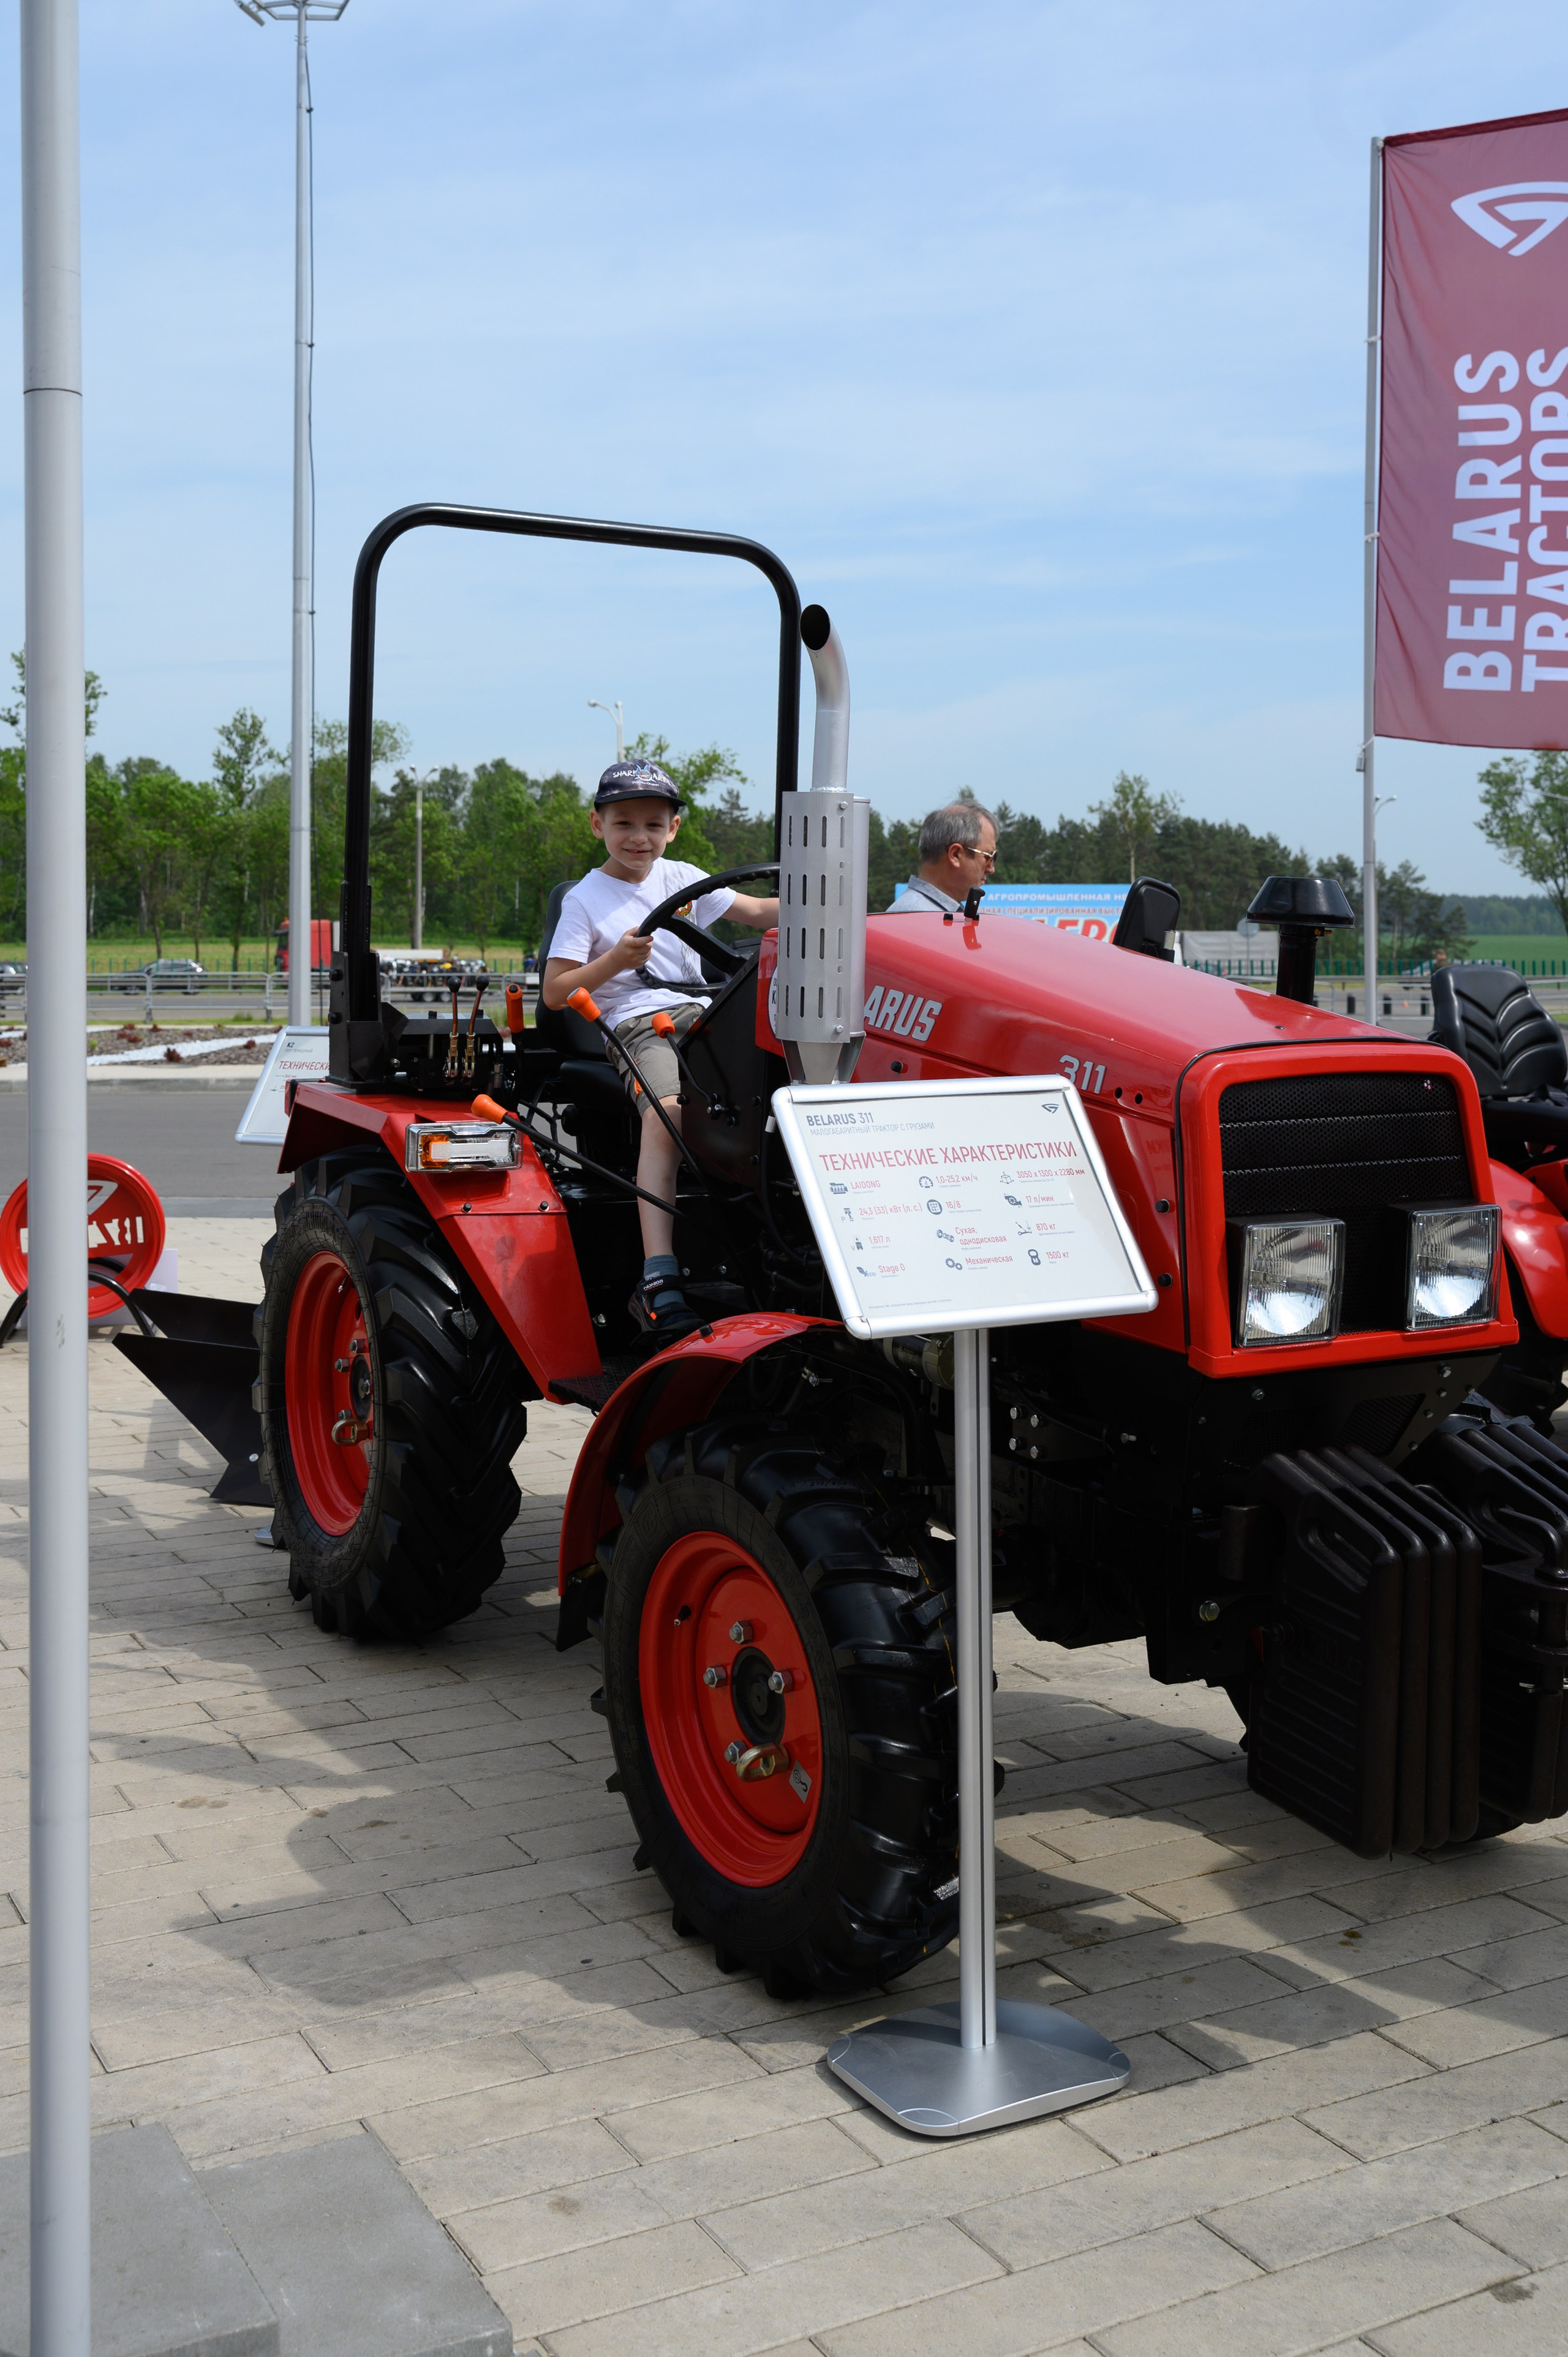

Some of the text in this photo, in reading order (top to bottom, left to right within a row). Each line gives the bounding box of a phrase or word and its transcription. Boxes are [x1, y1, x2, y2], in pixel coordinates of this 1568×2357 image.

[1442, 350, 1523, 692] BELARUS
[987, 893, 1111, 902] АГРОПРОМЫШЛЕННАЯ
[1055, 1054, 1106, 1095] 311
[806, 1112, 874, 1126] BELARUS 311
[810, 1125, 871, 1136] МАЛОГАБАРИТНЫЙ
[872, 1124, 899, 1133] ТРАКТОР
[907, 1122, 935, 1130] ГРУЗАМИ
[819, 1141, 1077, 1171] ТЕХНИЧЕСКИЕ ХАРАКТЕРИСТИКИ
[936, 1173, 978, 1184] 1,0-25,2 км/ч
[851, 1180, 881, 1190] LAIDONG
[1025, 1194, 1054, 1204] 17 л/мин
[859, 1207, 873, 1216] 24,3
[874, 1205, 888, 1215] (33)
[946, 1201, 961, 1210] 16/8
[955, 1226, 978, 1235] Сухая,
[959, 1236, 1007, 1246] однодисковая
[965, 1256, 1013, 1265] Механическая
[878, 1264, 899, 1273] Stage
